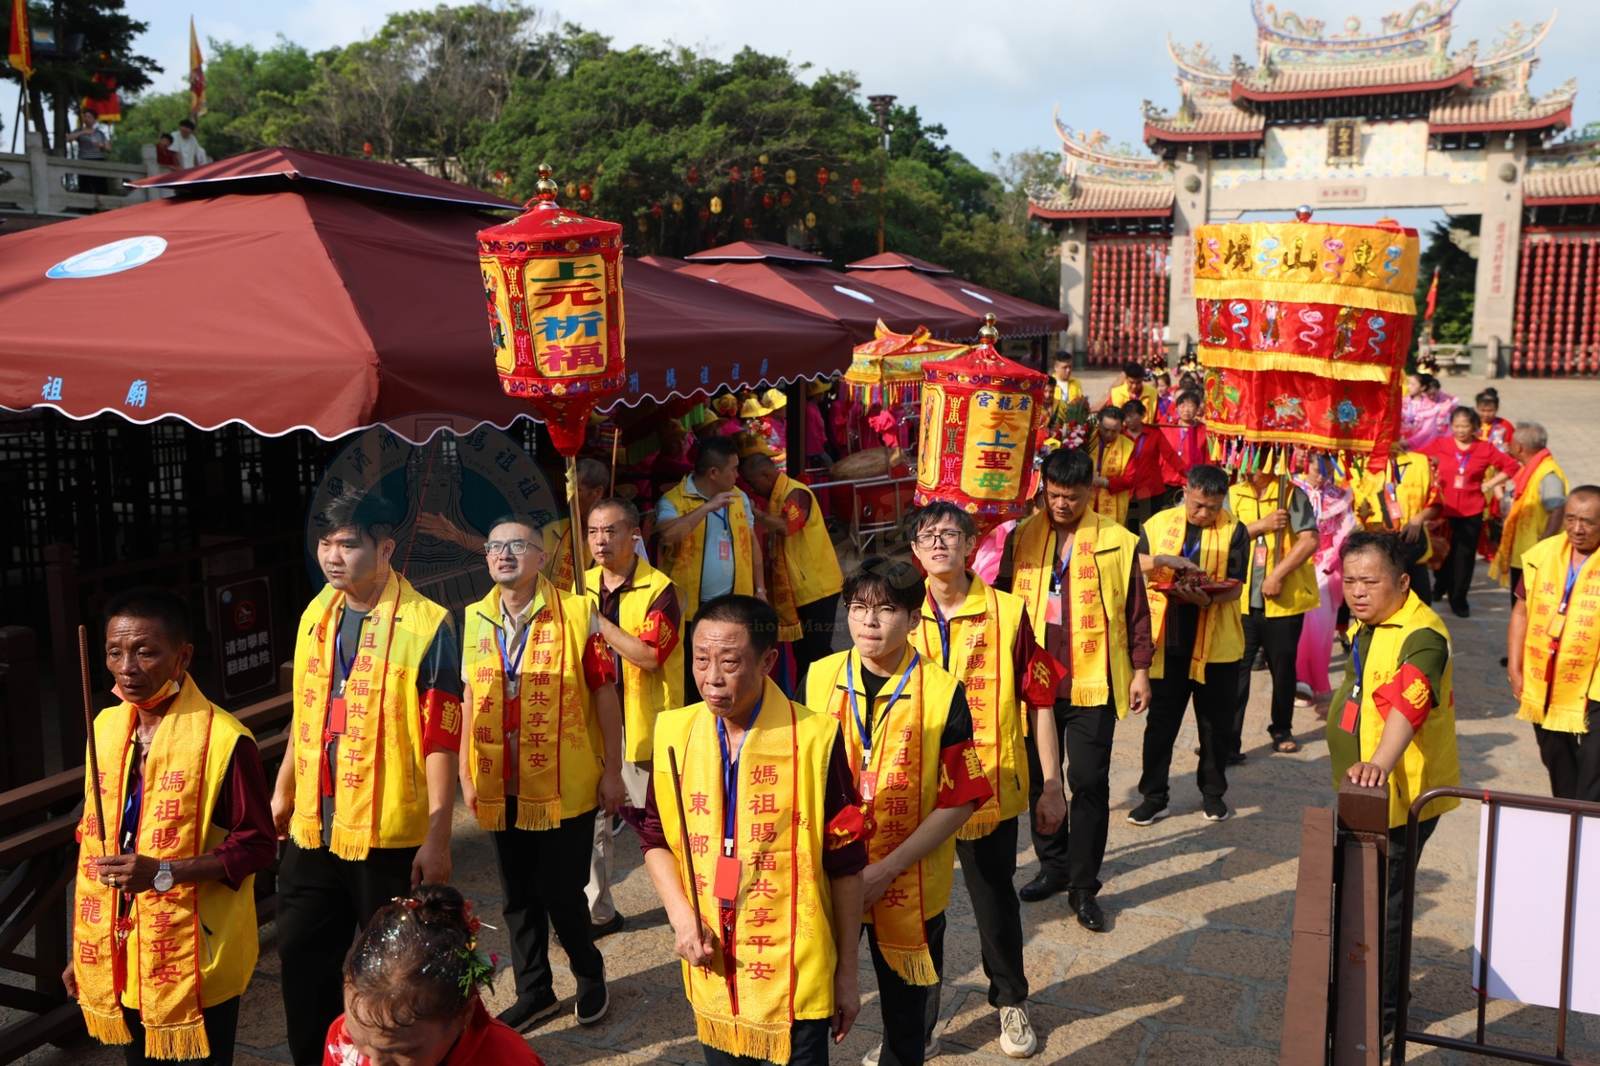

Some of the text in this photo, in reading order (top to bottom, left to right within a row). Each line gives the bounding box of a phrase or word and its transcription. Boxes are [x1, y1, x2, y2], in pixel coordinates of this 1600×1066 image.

[531, 261, 604, 372] 上元祈福
[41, 376, 147, 407] 祖廟
[974, 412, 1018, 491] 天上聖母
[1078, 542, 1098, 654] 東鄉蒼龍宮
[475, 636, 494, 774] 東鄉蒼龍宮
[527, 609, 554, 769] 媽祖賜福共享平安
[145, 770, 187, 987] 媽祖賜享平安
[744, 764, 780, 981] 媽祖賜福共享平安
